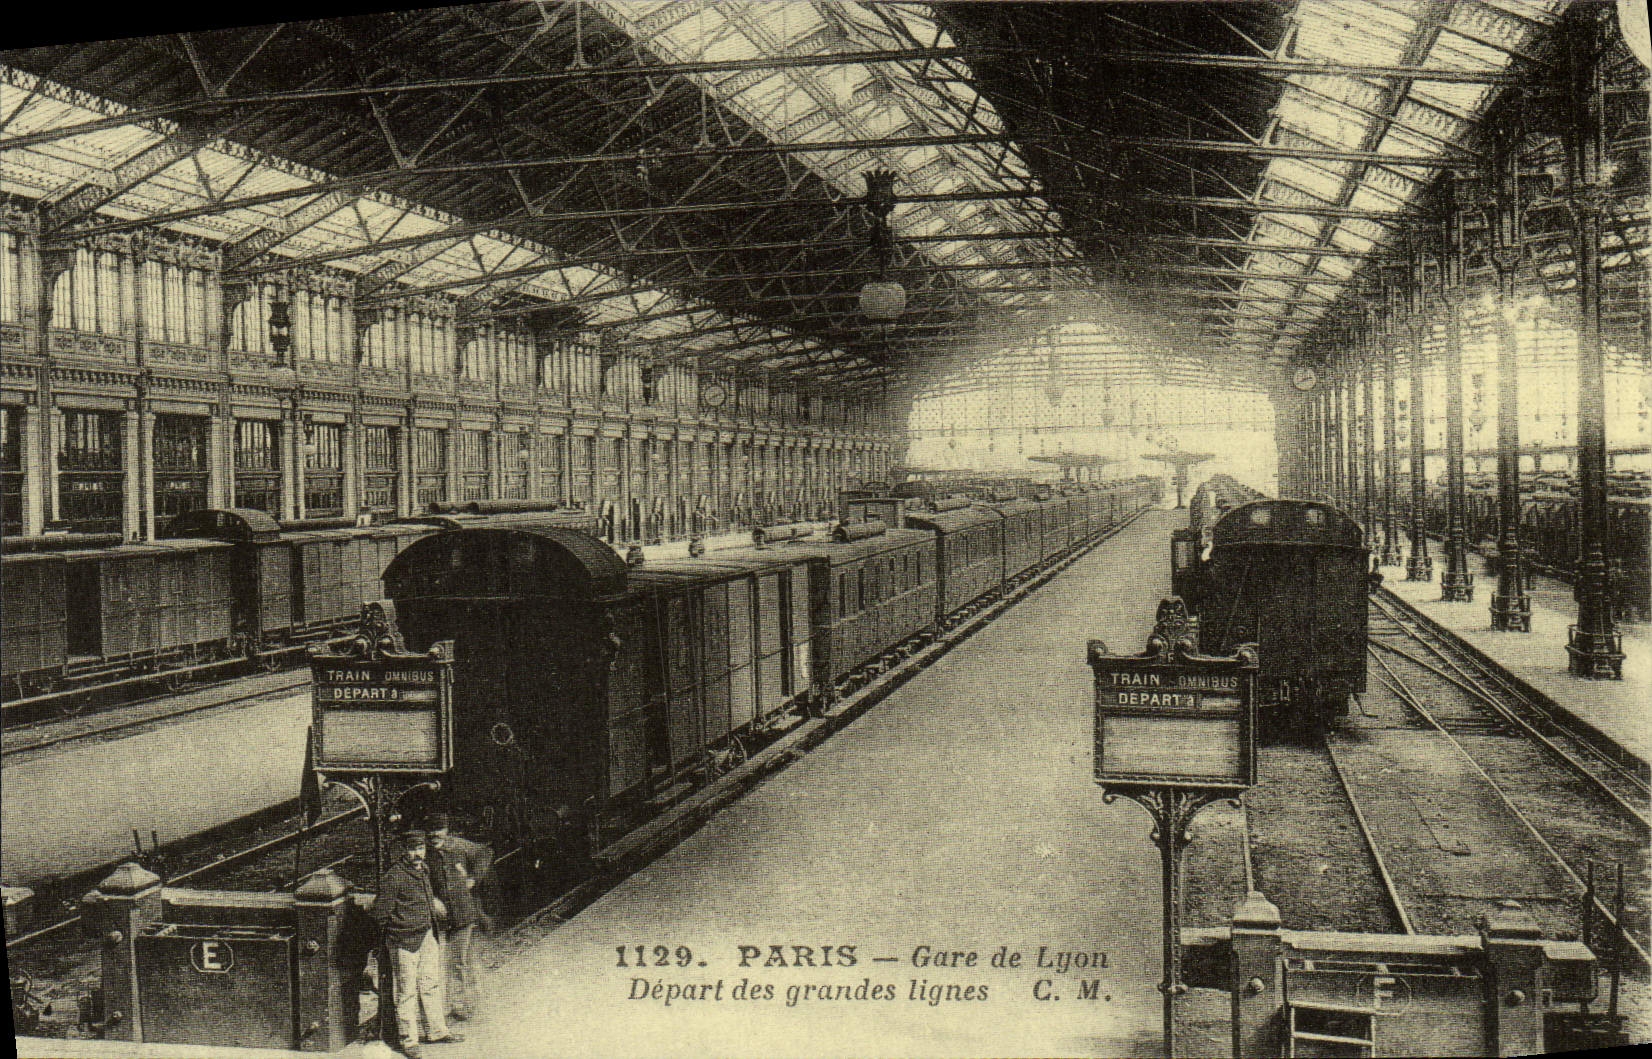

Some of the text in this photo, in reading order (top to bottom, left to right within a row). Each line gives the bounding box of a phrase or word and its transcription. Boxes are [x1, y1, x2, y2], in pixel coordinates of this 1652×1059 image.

[327, 670, 434, 682] TRAIN OMNIBUS
[1111, 673, 1238, 688] TRAIN OMNIBUS
[202, 942, 222, 969] E
